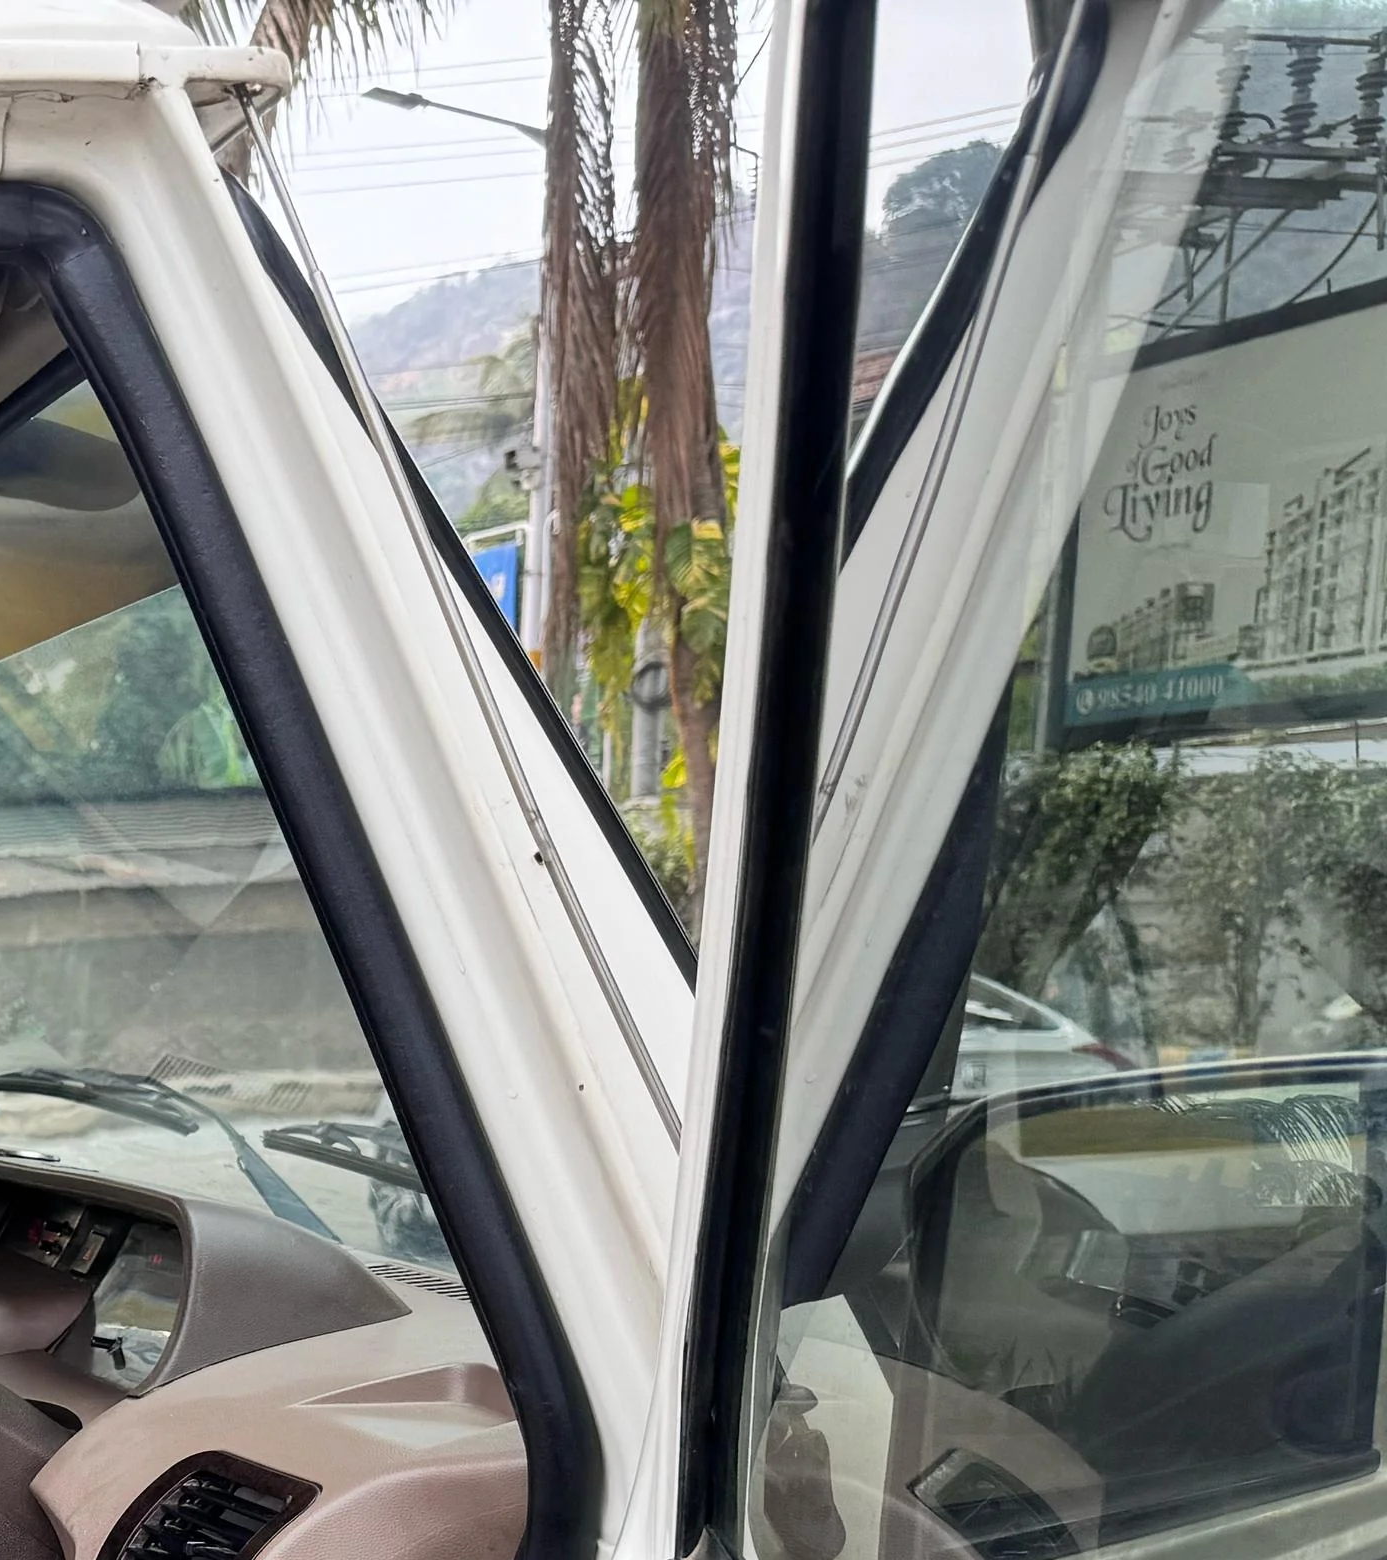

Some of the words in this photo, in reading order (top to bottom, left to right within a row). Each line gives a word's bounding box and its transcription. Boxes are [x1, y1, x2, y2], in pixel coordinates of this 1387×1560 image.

[1138, 404, 1198, 449] Joys
[1141, 433, 1218, 486] Good
[1104, 474, 1214, 543] Living
